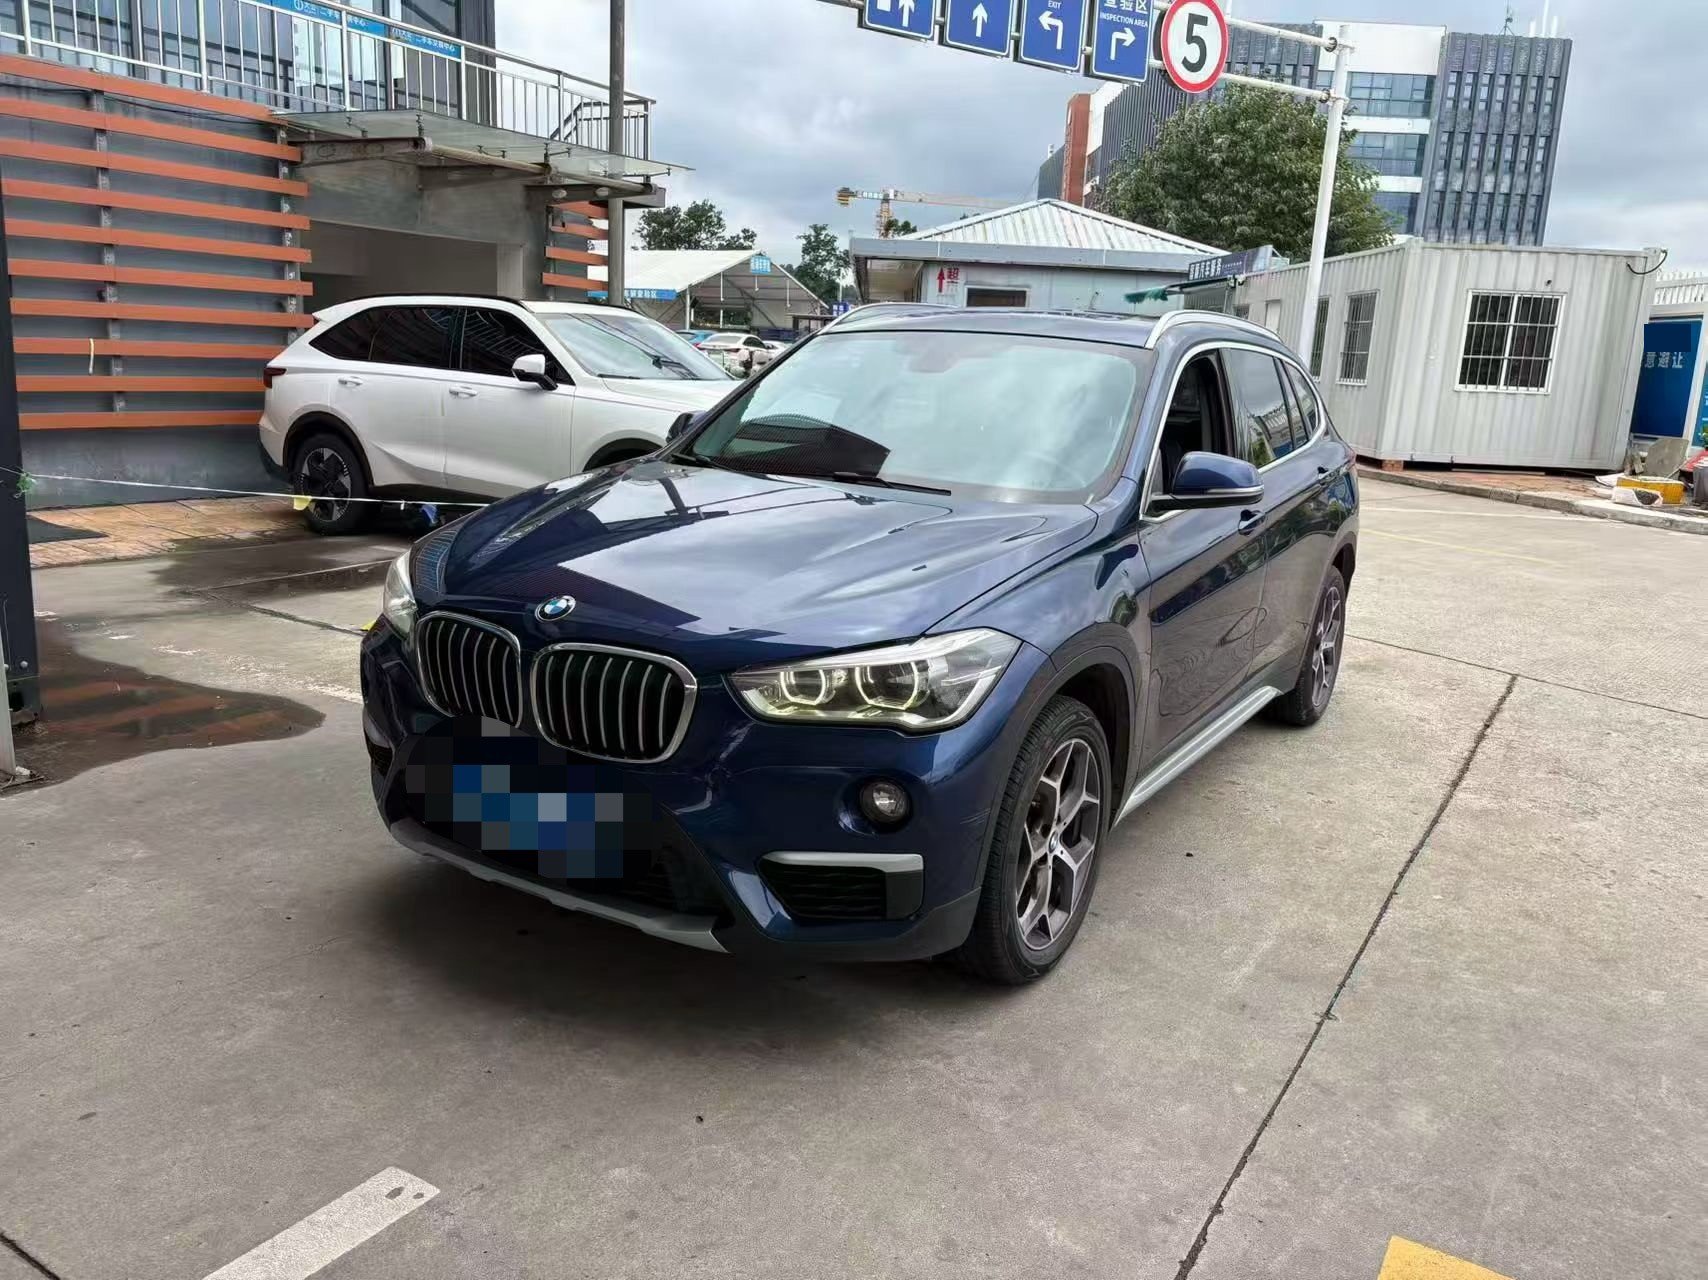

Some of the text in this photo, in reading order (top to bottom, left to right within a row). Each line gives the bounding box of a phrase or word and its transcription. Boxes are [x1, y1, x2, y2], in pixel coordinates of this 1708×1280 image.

[1100, 12, 1149, 28] INSPECTION AREA
[1181, 13, 1208, 73] 5
